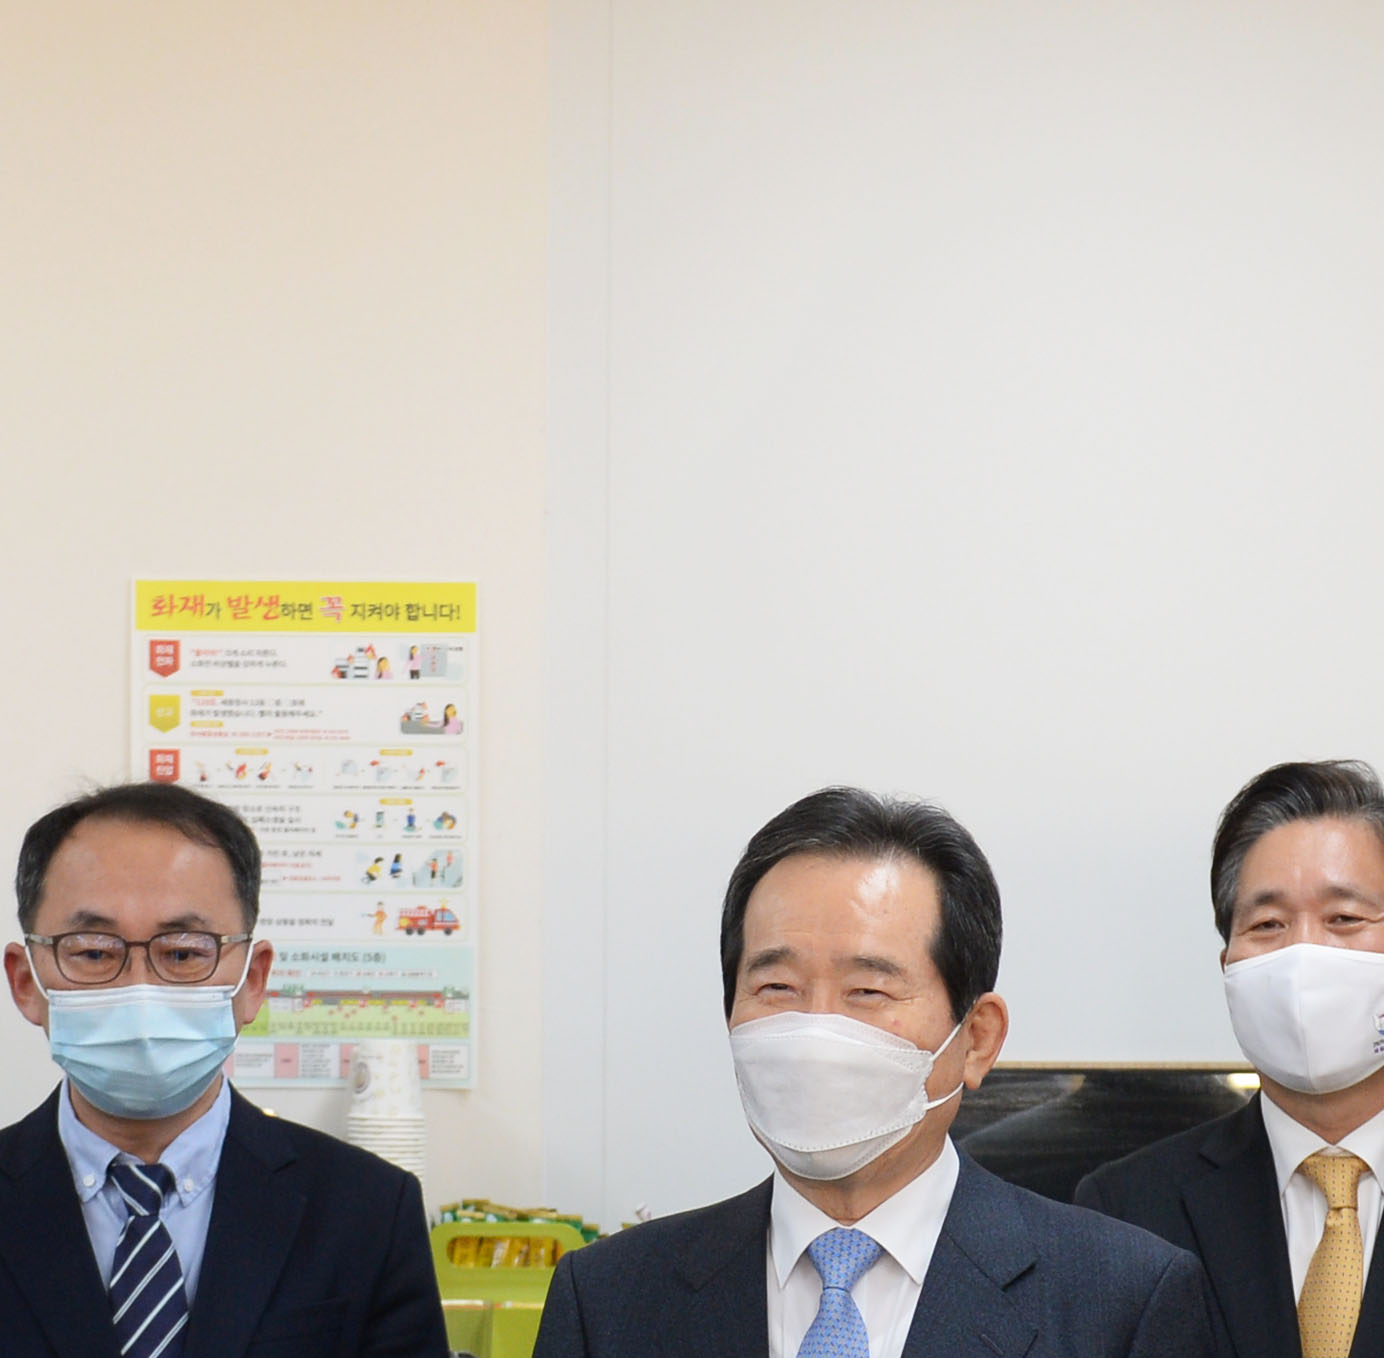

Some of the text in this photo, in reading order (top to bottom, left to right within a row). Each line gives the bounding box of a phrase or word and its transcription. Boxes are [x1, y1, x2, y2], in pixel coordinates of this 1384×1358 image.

[151, 594, 461, 621] 화재가 발생하면 꼭 지켜야 합니다!
